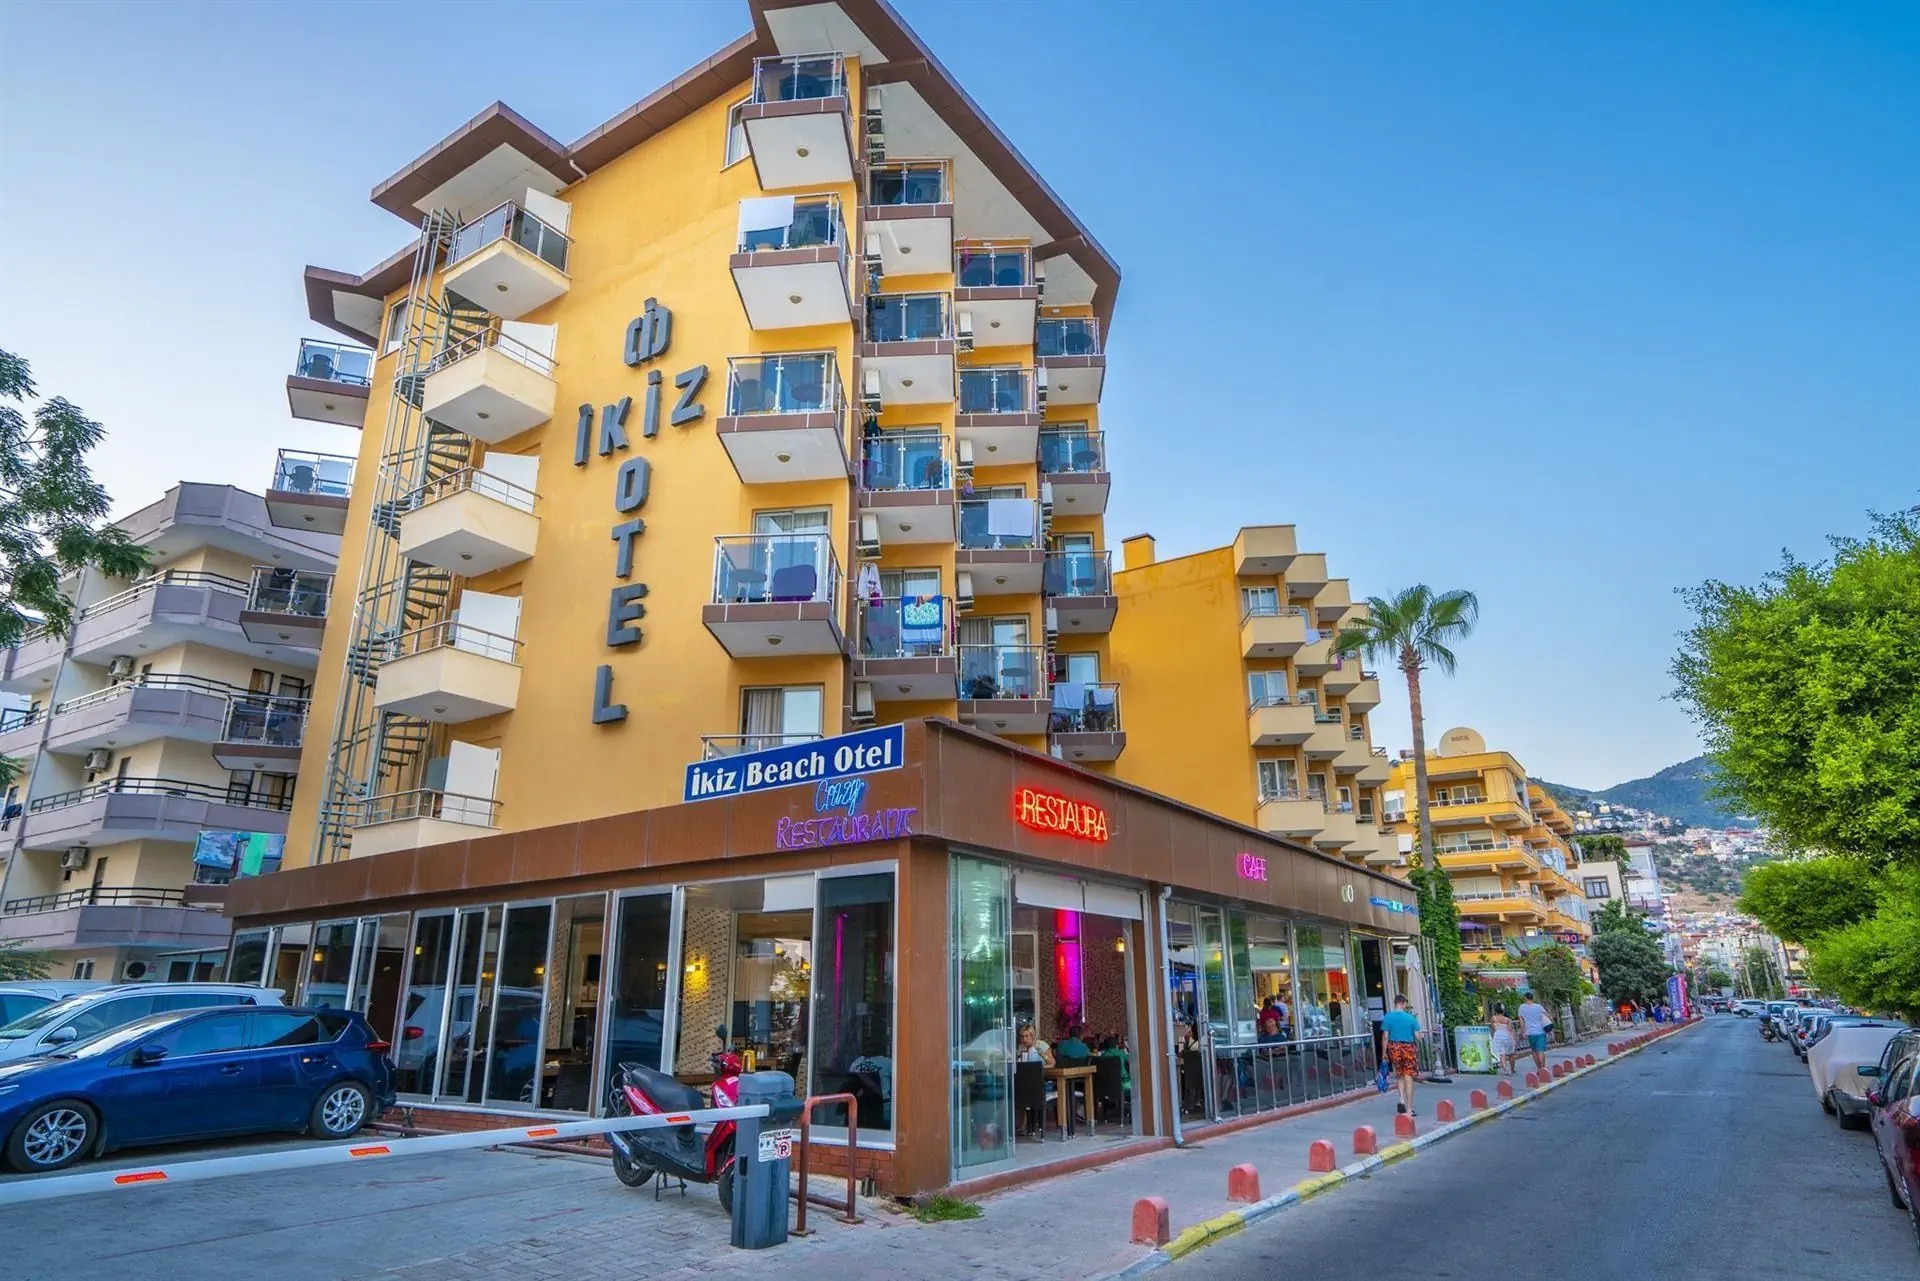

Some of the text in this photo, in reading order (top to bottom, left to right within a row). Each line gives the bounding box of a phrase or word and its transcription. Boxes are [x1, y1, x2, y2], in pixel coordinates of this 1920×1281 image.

[691, 738, 892, 797] İkiz Beach Otel
[776, 808, 916, 849] RESTAURANT
[1243, 853, 1268, 881] CAFE
